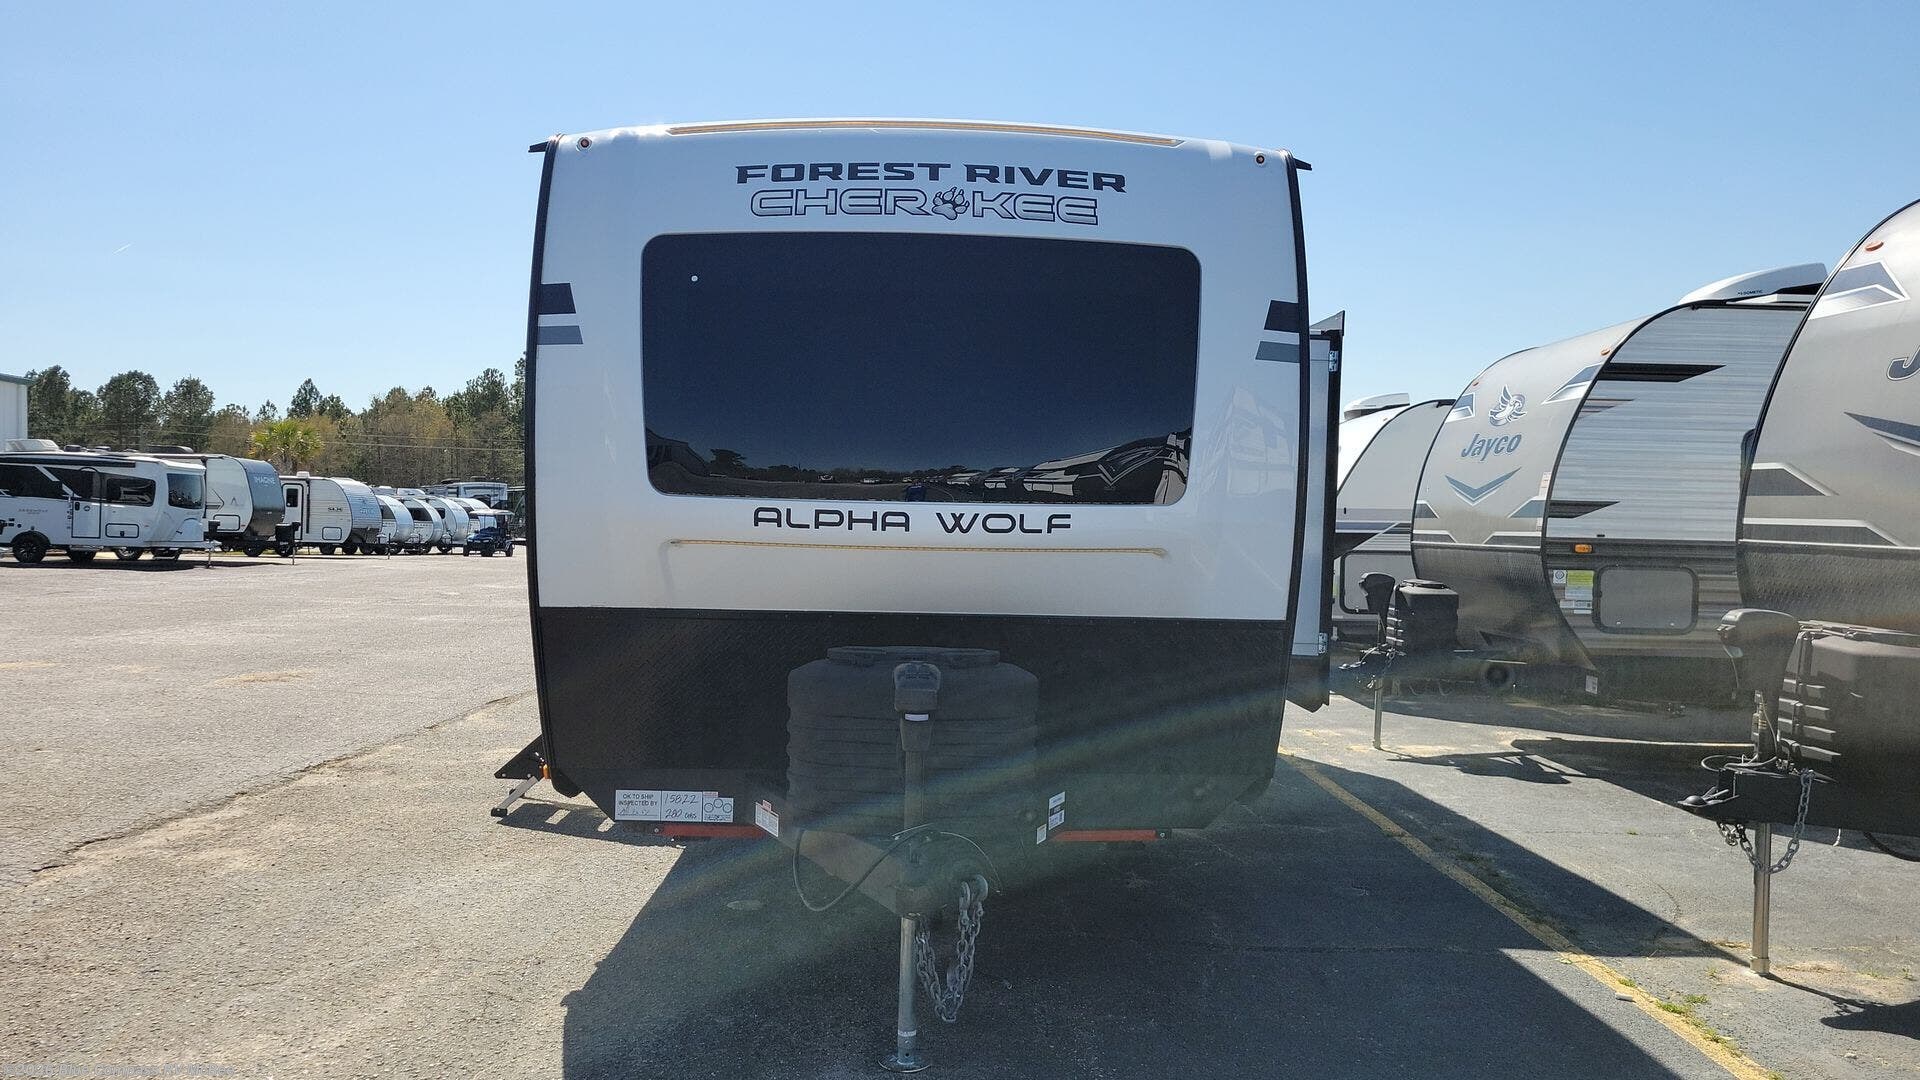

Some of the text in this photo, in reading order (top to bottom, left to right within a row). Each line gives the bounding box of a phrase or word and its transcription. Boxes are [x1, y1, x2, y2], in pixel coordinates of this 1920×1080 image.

[736, 163, 1126, 193] FOREST RIVER
[1461, 433, 1522, 461] Jayco
[753, 507, 1071, 534] ALPHA WOLF
